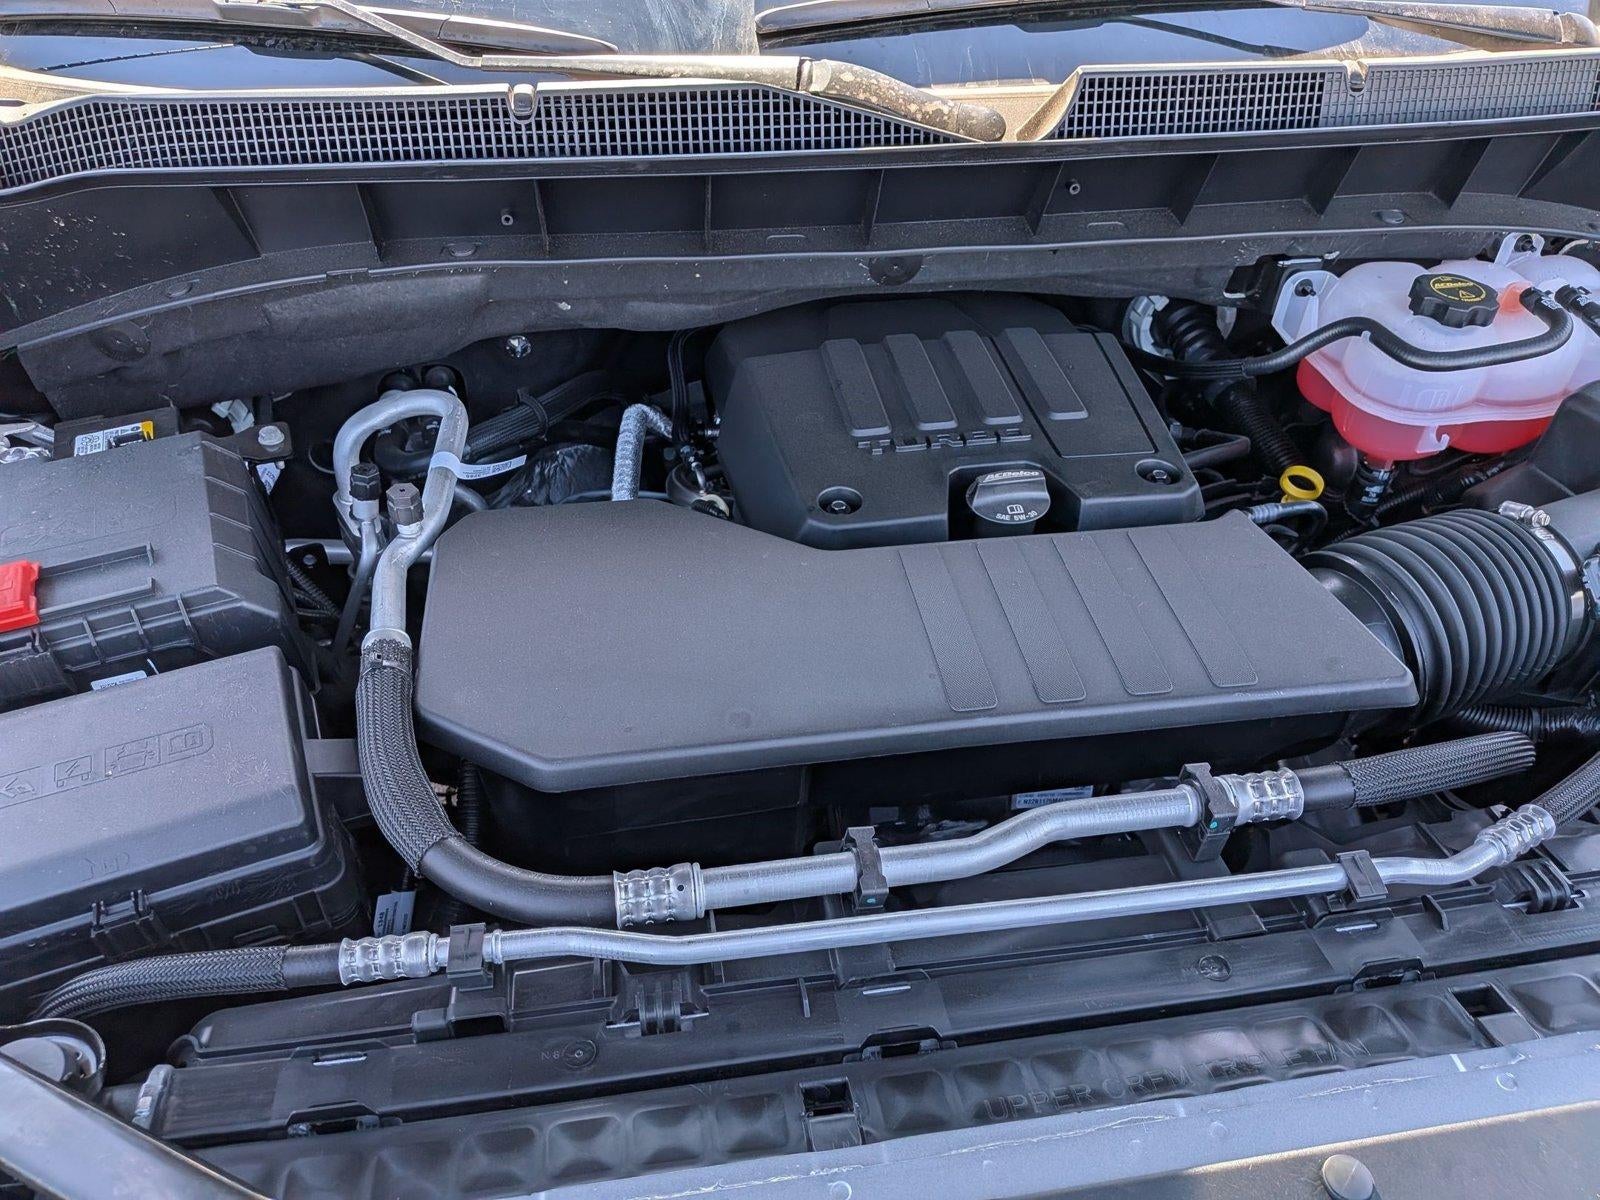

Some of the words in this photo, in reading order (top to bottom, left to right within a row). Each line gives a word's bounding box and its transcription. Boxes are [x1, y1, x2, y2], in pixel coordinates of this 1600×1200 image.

[983, 470, 1040, 483] ACDelco
[995, 513, 1011, 521] SAE
[1013, 510, 1038, 521] 5W-30
[984, 1083, 1095, 1121] UPPER
